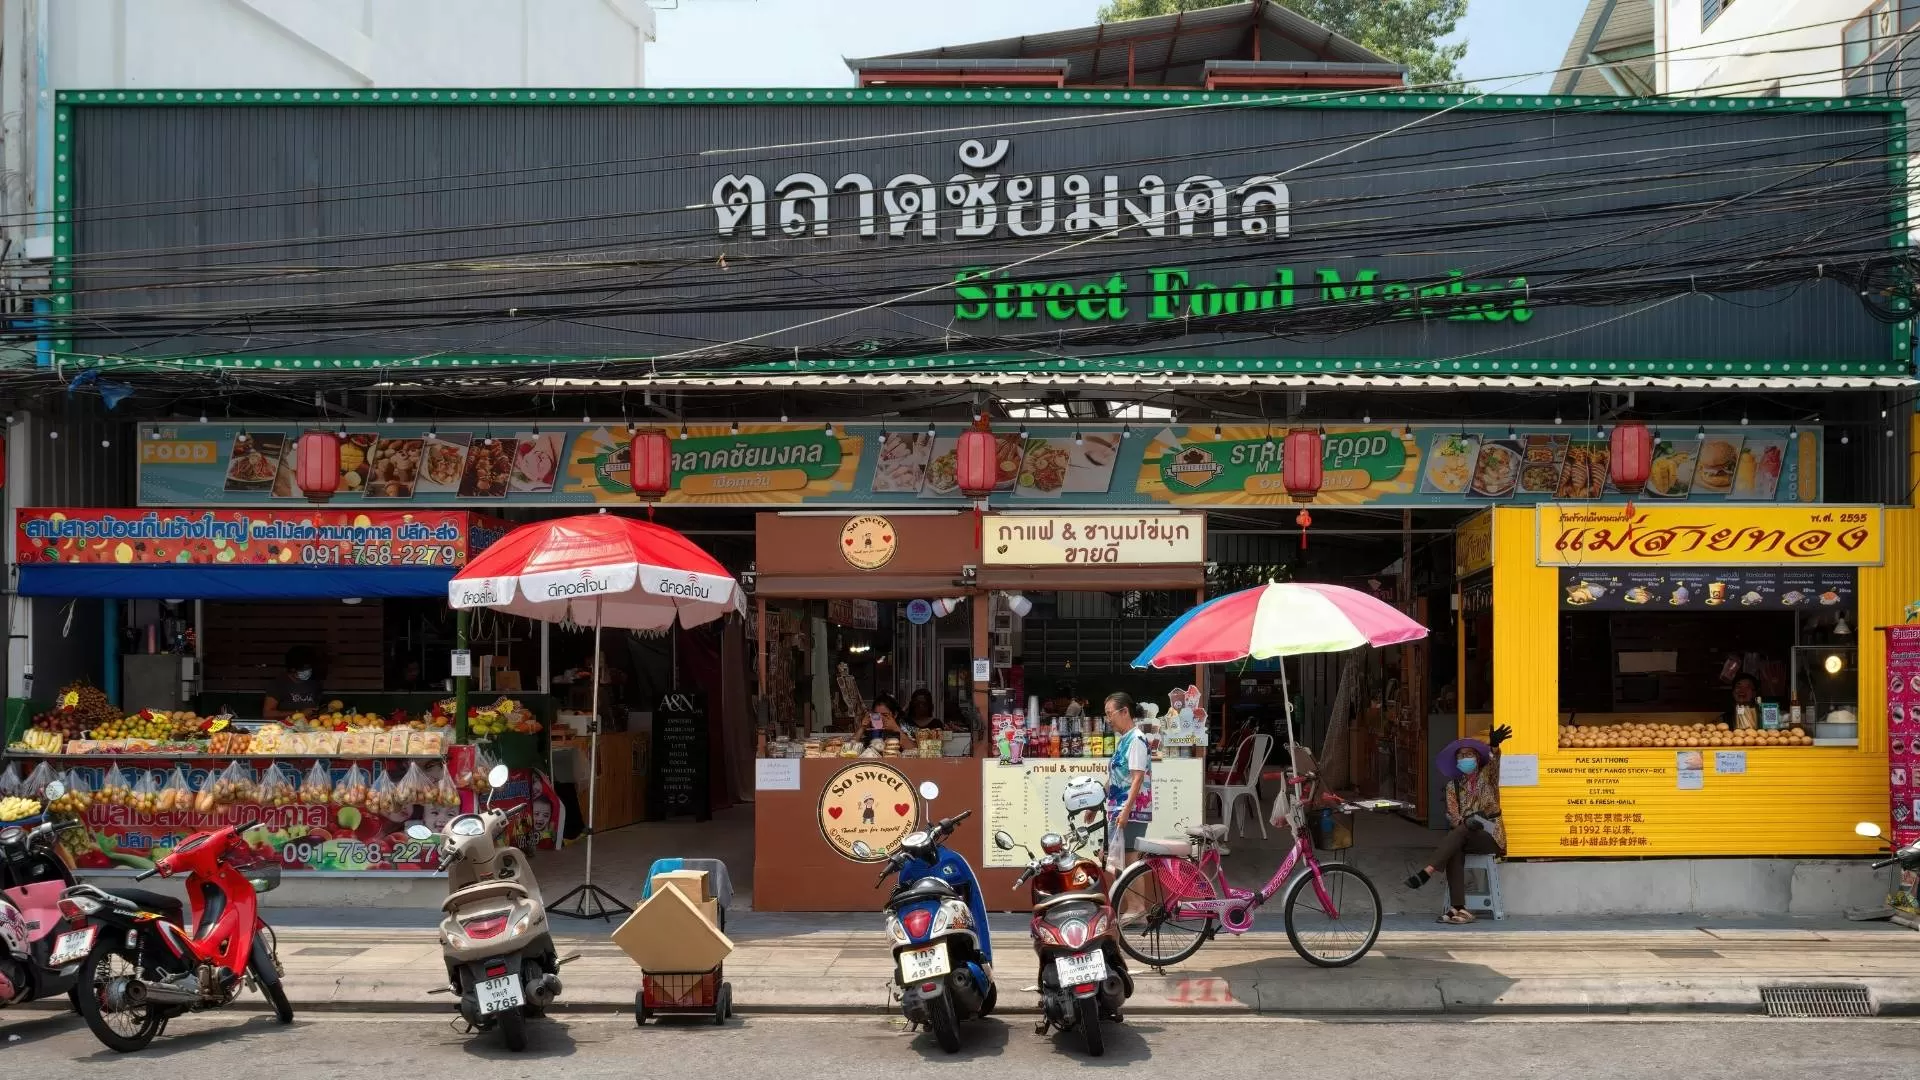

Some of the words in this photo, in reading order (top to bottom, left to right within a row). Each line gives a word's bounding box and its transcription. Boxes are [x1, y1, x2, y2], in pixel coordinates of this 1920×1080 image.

[712, 138, 1292, 239] ตลาดชัยมงคล
[954, 265, 1129, 321] Street
[1147, 267, 1295, 317] Food
[143, 444, 209, 460] FOOD
[1231, 444, 1284, 465] STRE
[1325, 437, 1388, 458] FOOD
[999, 520, 1053, 540] กาแฟ
[1062, 523, 1076, 540] &
[1085, 518, 1189, 546] ชานมไข่มุก
[1554, 515, 1869, 557] แม่สายทอง
[302, 544, 456, 565] 091-758-2279
[1065, 542, 1120, 563] ขายดี
[658, 693, 696, 712] A&N
[1033, 763, 1057, 773] กาแฟ
[1060, 765, 1067, 773] &
[1069, 763, 1109, 774] ชานมไข่มุ
[831, 778, 853, 797] So
[855, 771, 904, 792] sweet
[834, 834, 853, 849] 0659
[282, 842, 443, 864] 091-758-227
[486, 996, 518, 1011] 3765
